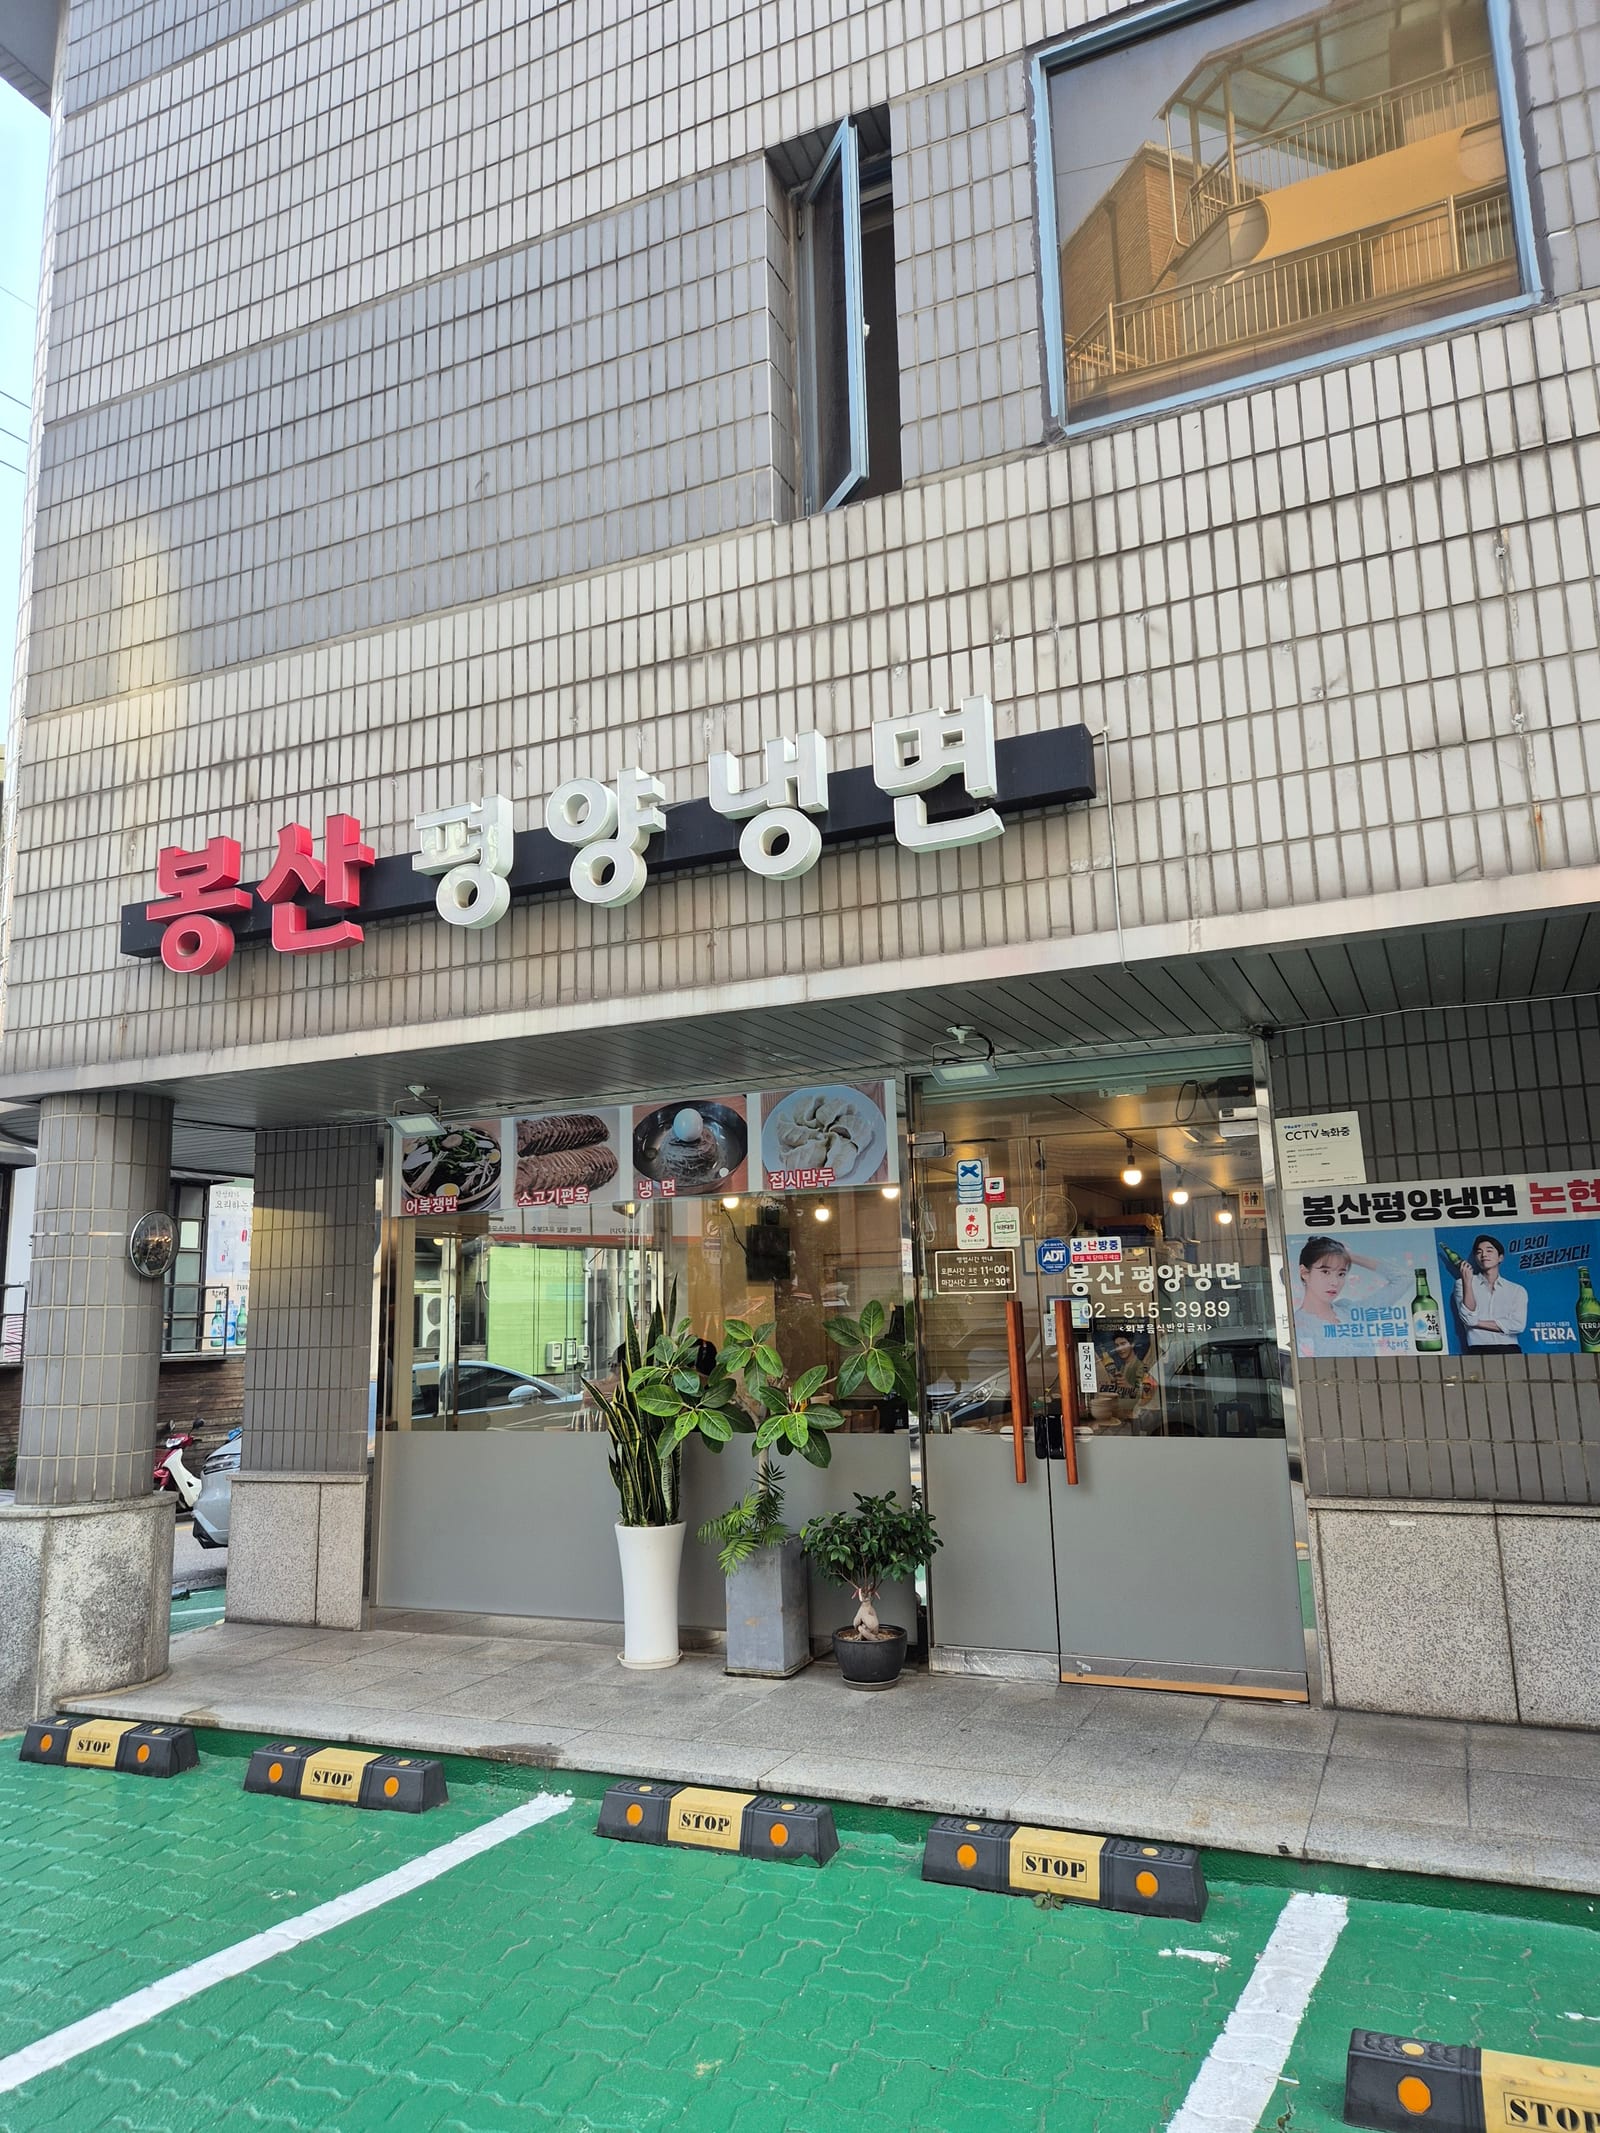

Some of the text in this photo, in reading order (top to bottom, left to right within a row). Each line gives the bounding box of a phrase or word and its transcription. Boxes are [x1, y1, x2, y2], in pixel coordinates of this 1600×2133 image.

[146, 694, 1006, 975] 봉산 평양냉면
[1285, 1126, 1351, 1141] CCTV 녹화중
[768, 1167, 836, 1190] 접시만두
[405, 1196, 458, 1215] 어복쟁반
[517, 1185, 590, 1207] 소고기편육
[1302, 1183, 1518, 1227] 봉산평양냉면
[1509, 1234, 1549, 1253] 이 맛이
[1043, 1250, 1065, 1262] ADT
[1519, 1244, 1590, 1270] 청정라거다!
[1067, 1262, 1242, 1296] 봉산 평양냉면
[1082, 1301, 1230, 1319] 02-515-3989
[1351, 1306, 1406, 1322] 이슬같이
[1323, 1323, 1409, 1338] 깨끗한 다음날
[1530, 1327, 1577, 1342] TERRA
[1082, 1345, 1093, 1380] 당기시오
[77, 1740, 111, 1753] STOP
[313, 1770, 352, 1786] STOP
[681, 1813, 730, 1833] STOP
[1025, 1855, 1086, 1879] STOP
[1509, 2098, 1600, 2133] STOP
